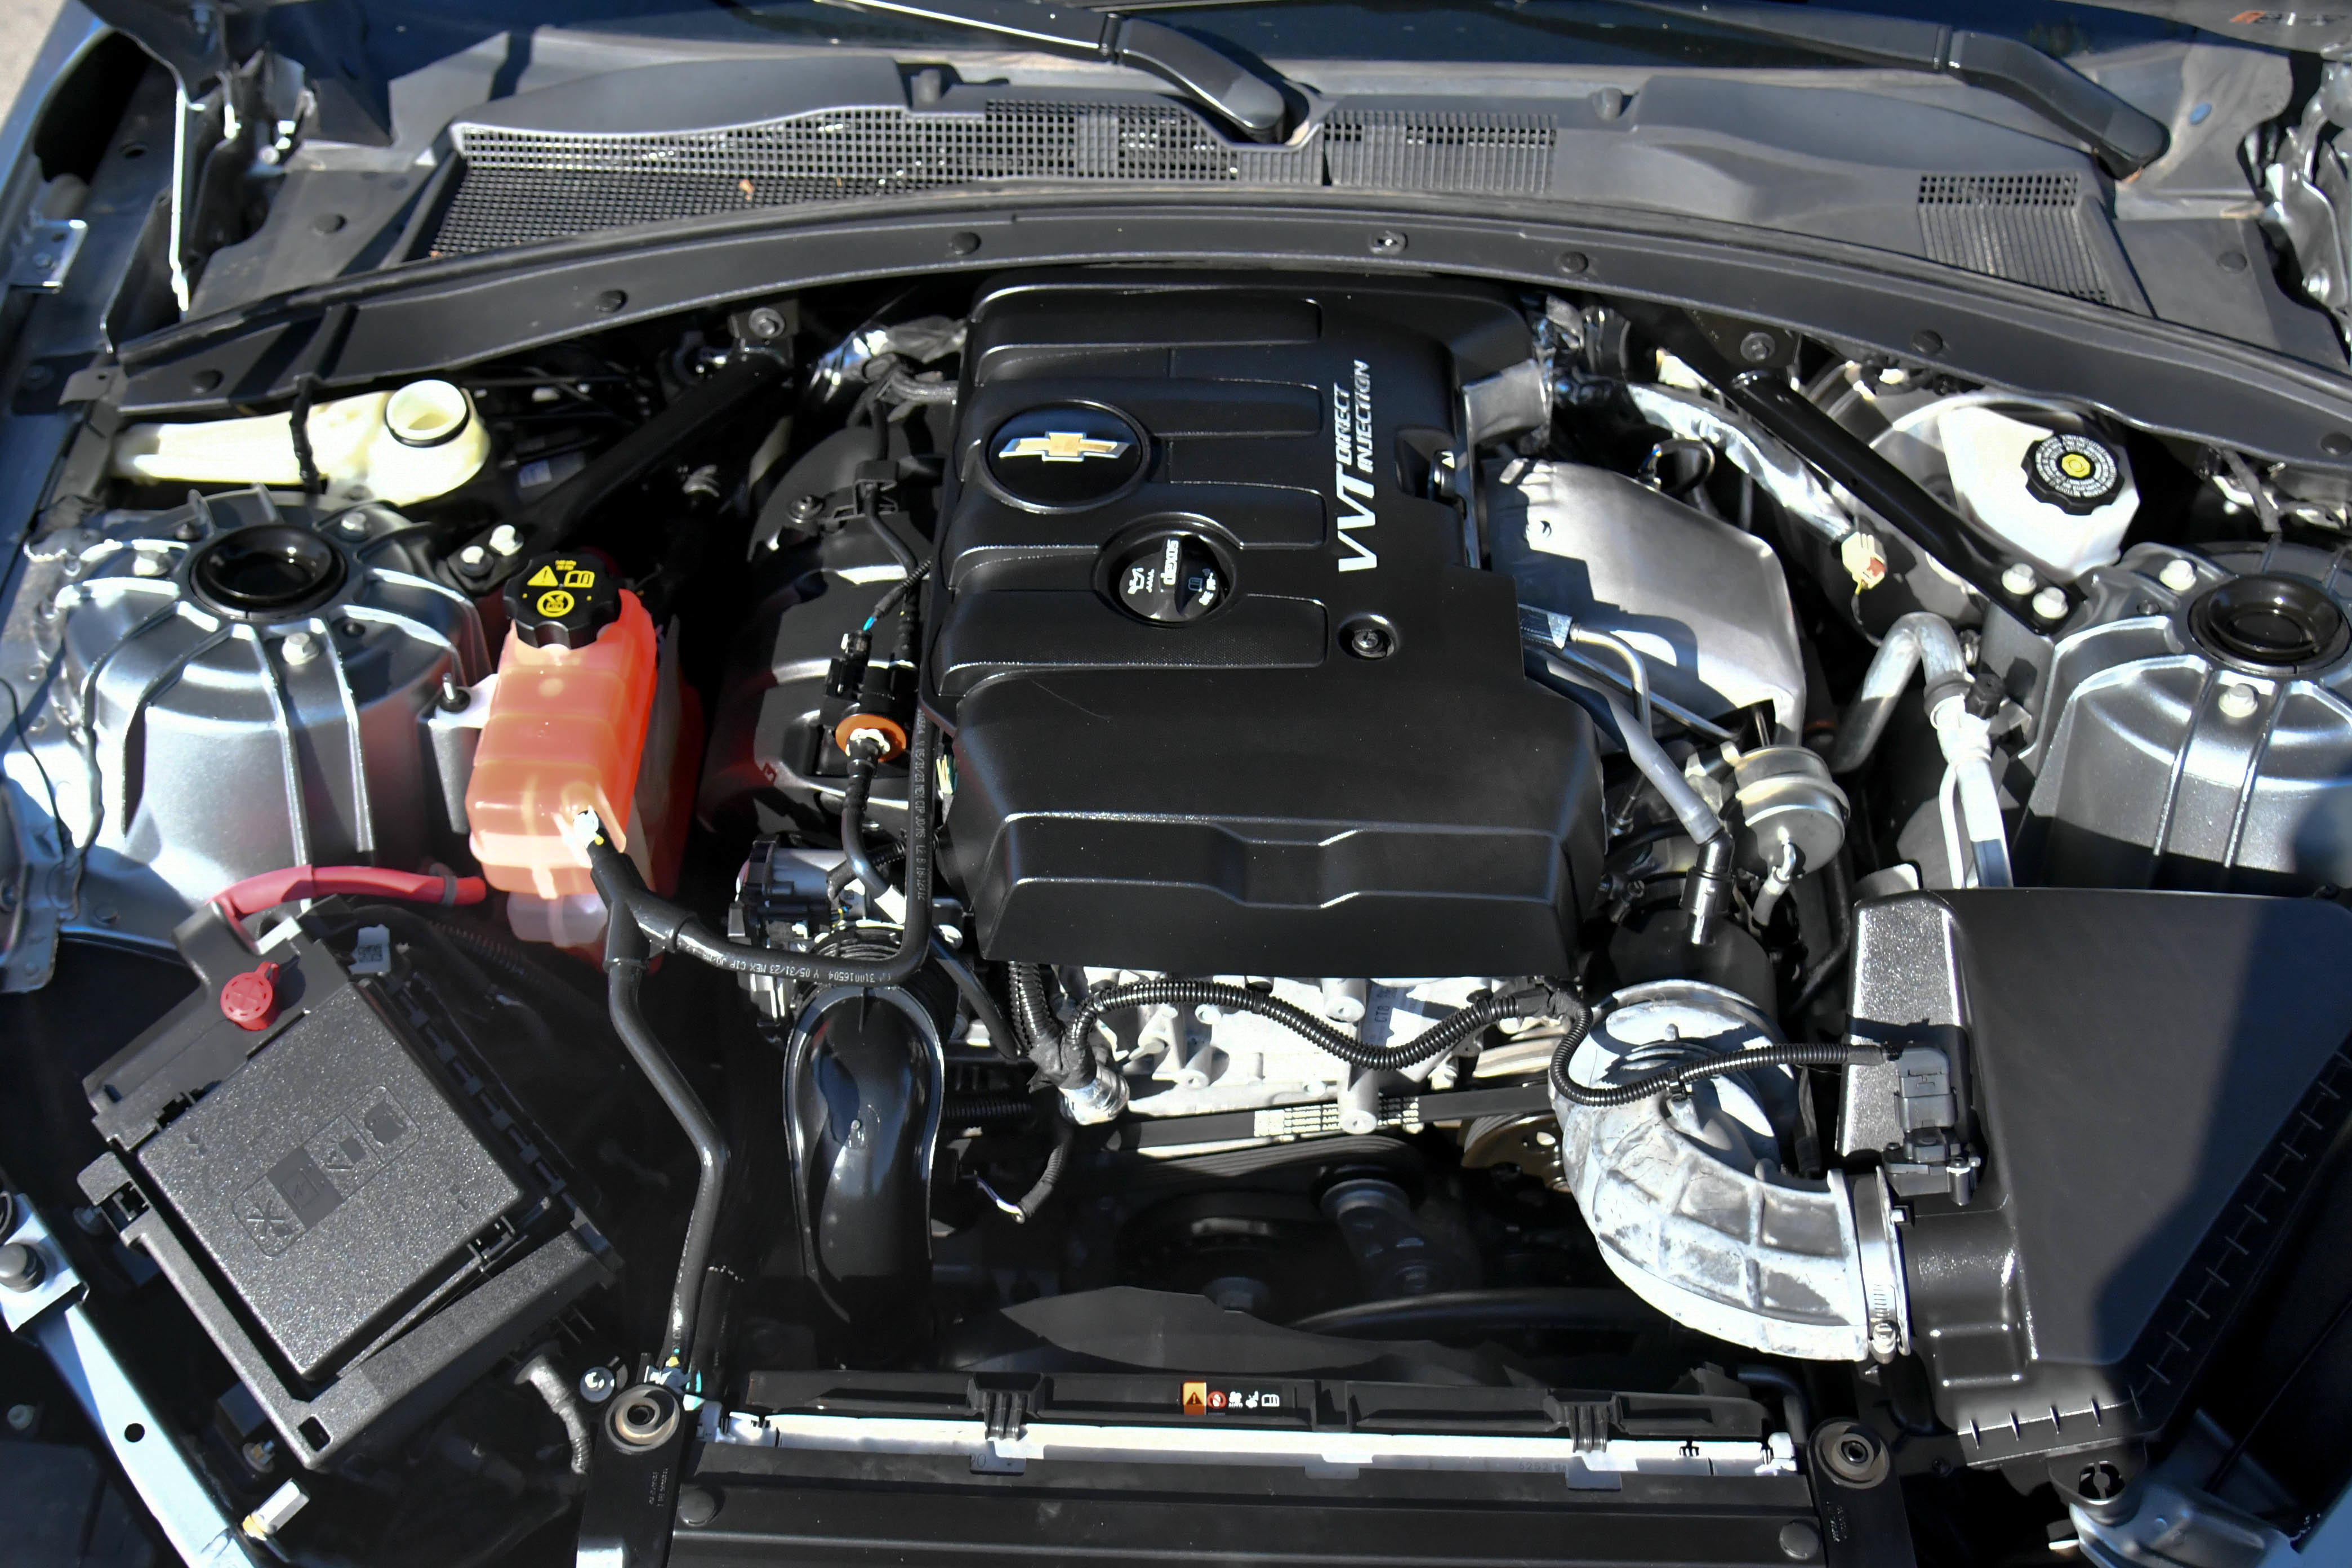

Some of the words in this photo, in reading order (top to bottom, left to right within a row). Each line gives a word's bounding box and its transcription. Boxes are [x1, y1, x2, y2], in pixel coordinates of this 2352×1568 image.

[1334, 382, 1352, 465] DIRECT
[1353, 359, 1374, 474] INJECTION
[1336, 463, 1377, 572] VVT
[1161, 539, 1179, 585] dexos
[915, 748, 925, 782] 05/31/23
[915, 785, 925, 798] MEX
[750, 963, 767, 973] MEX
[770, 964, 811, 978] 05/31/23
[828, 970, 876, 983] 310016504
